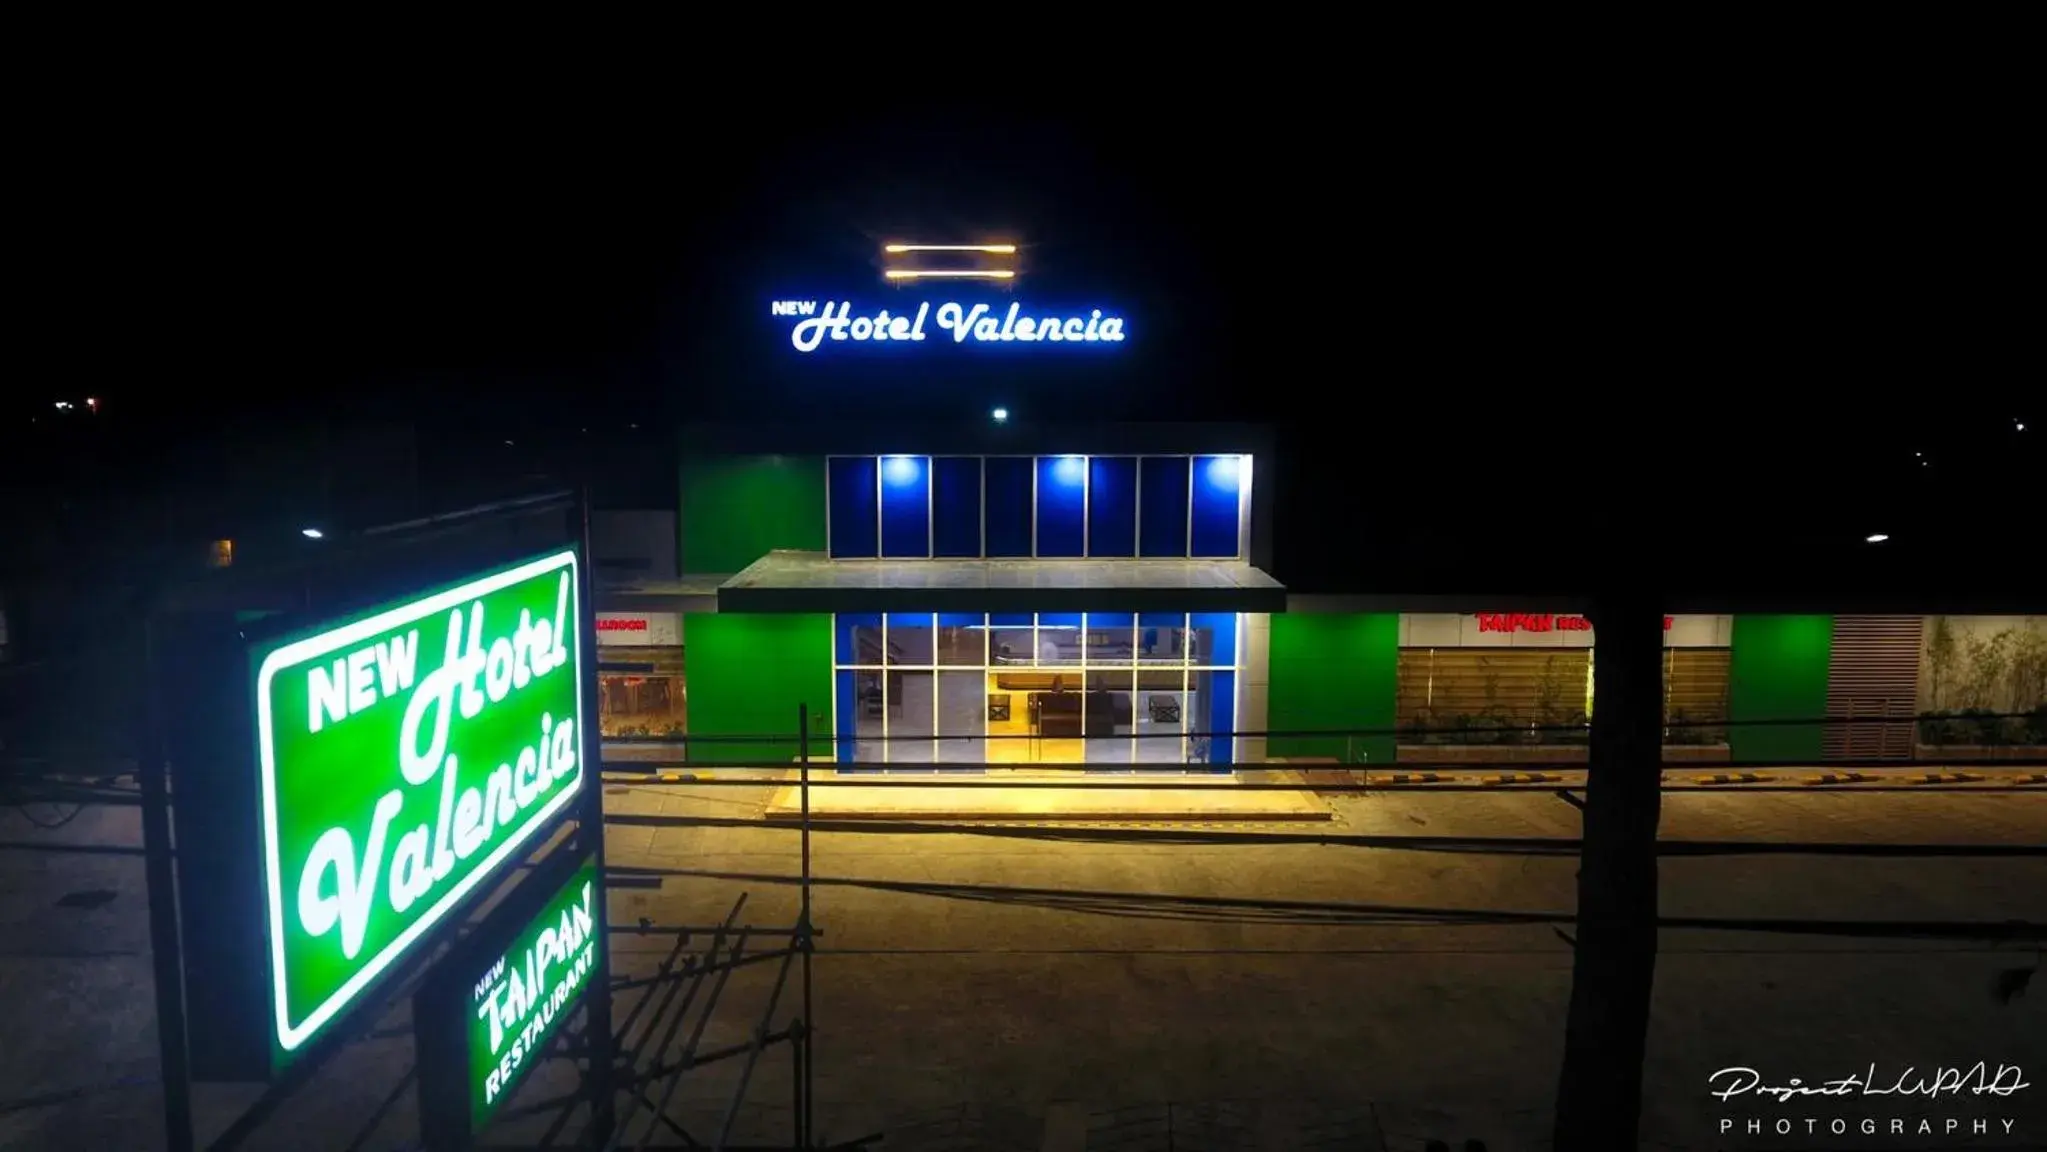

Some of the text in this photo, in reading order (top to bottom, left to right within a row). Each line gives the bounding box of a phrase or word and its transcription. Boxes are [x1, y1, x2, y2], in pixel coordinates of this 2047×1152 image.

[772, 301, 1125, 351] NEW Hotel Valencia
[308, 570, 569, 785] NEW Hotel
[596, 619, 647, 631] LLROOM
[298, 711, 575, 959] Valencia
[474, 955, 506, 1001] NEW
[478, 880, 593, 1055] TAIPAN
[485, 941, 594, 1104] RESTAURANT
